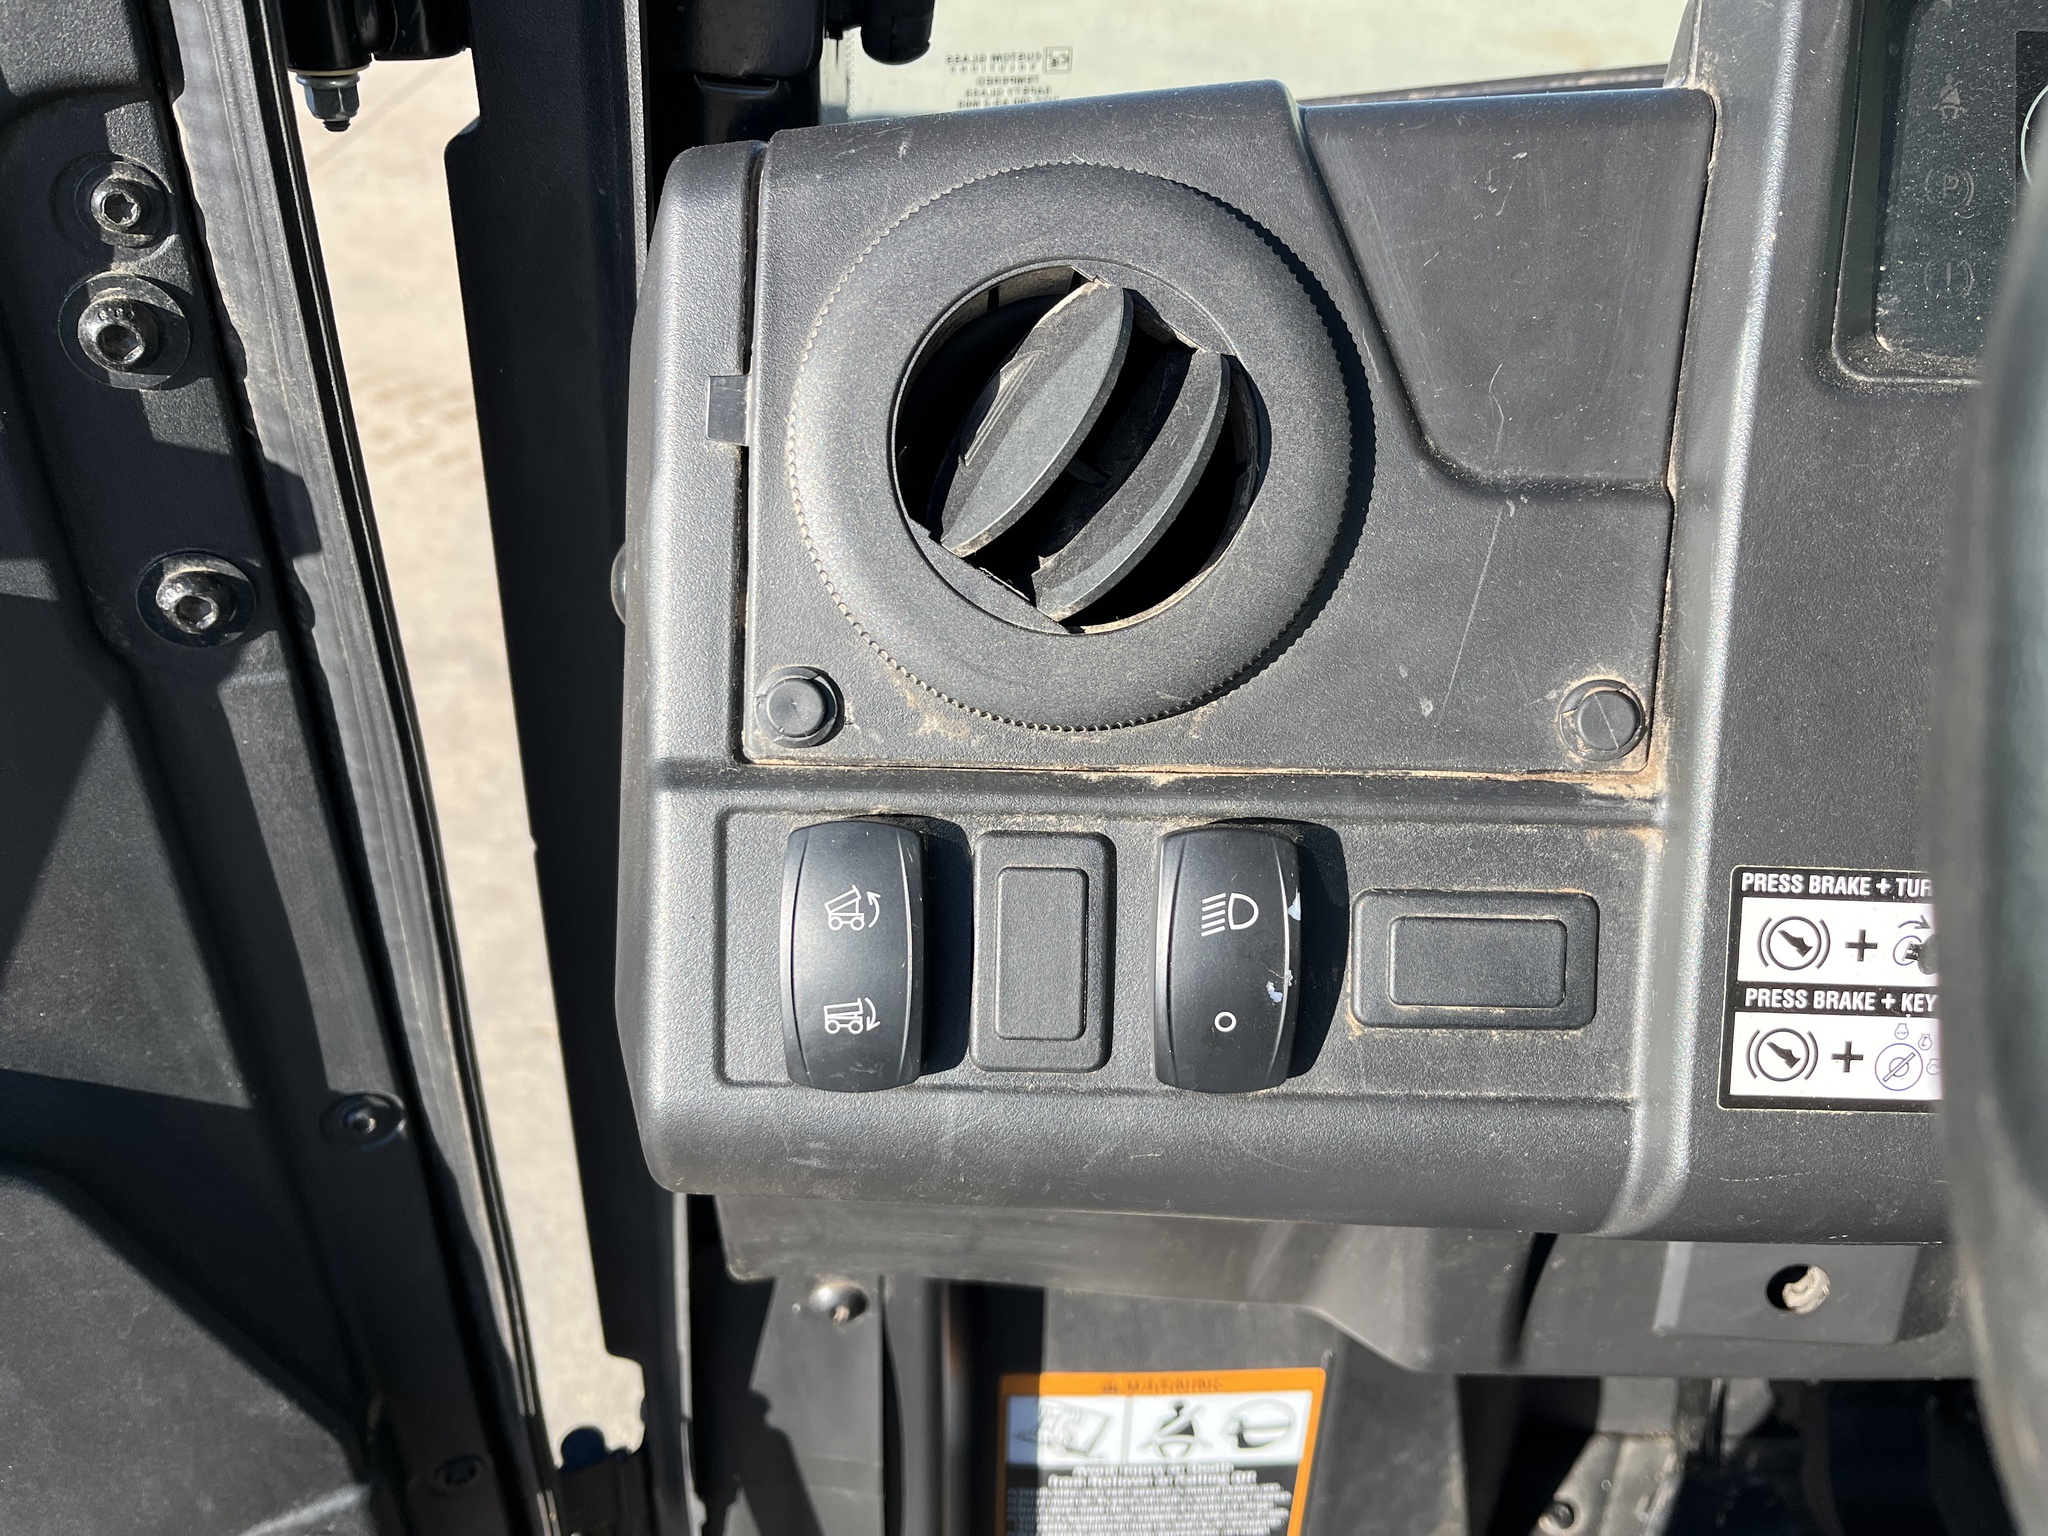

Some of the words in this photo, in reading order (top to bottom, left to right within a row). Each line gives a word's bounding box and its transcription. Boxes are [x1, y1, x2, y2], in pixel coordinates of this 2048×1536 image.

[1741, 872, 1804, 894] PRESS
[1808, 874, 1871, 896] BRAKE
[1745, 987, 1808, 1009] PRESS
[1813, 990, 1877, 1011] BRAKE
[1901, 992, 1938, 1013] KEY
